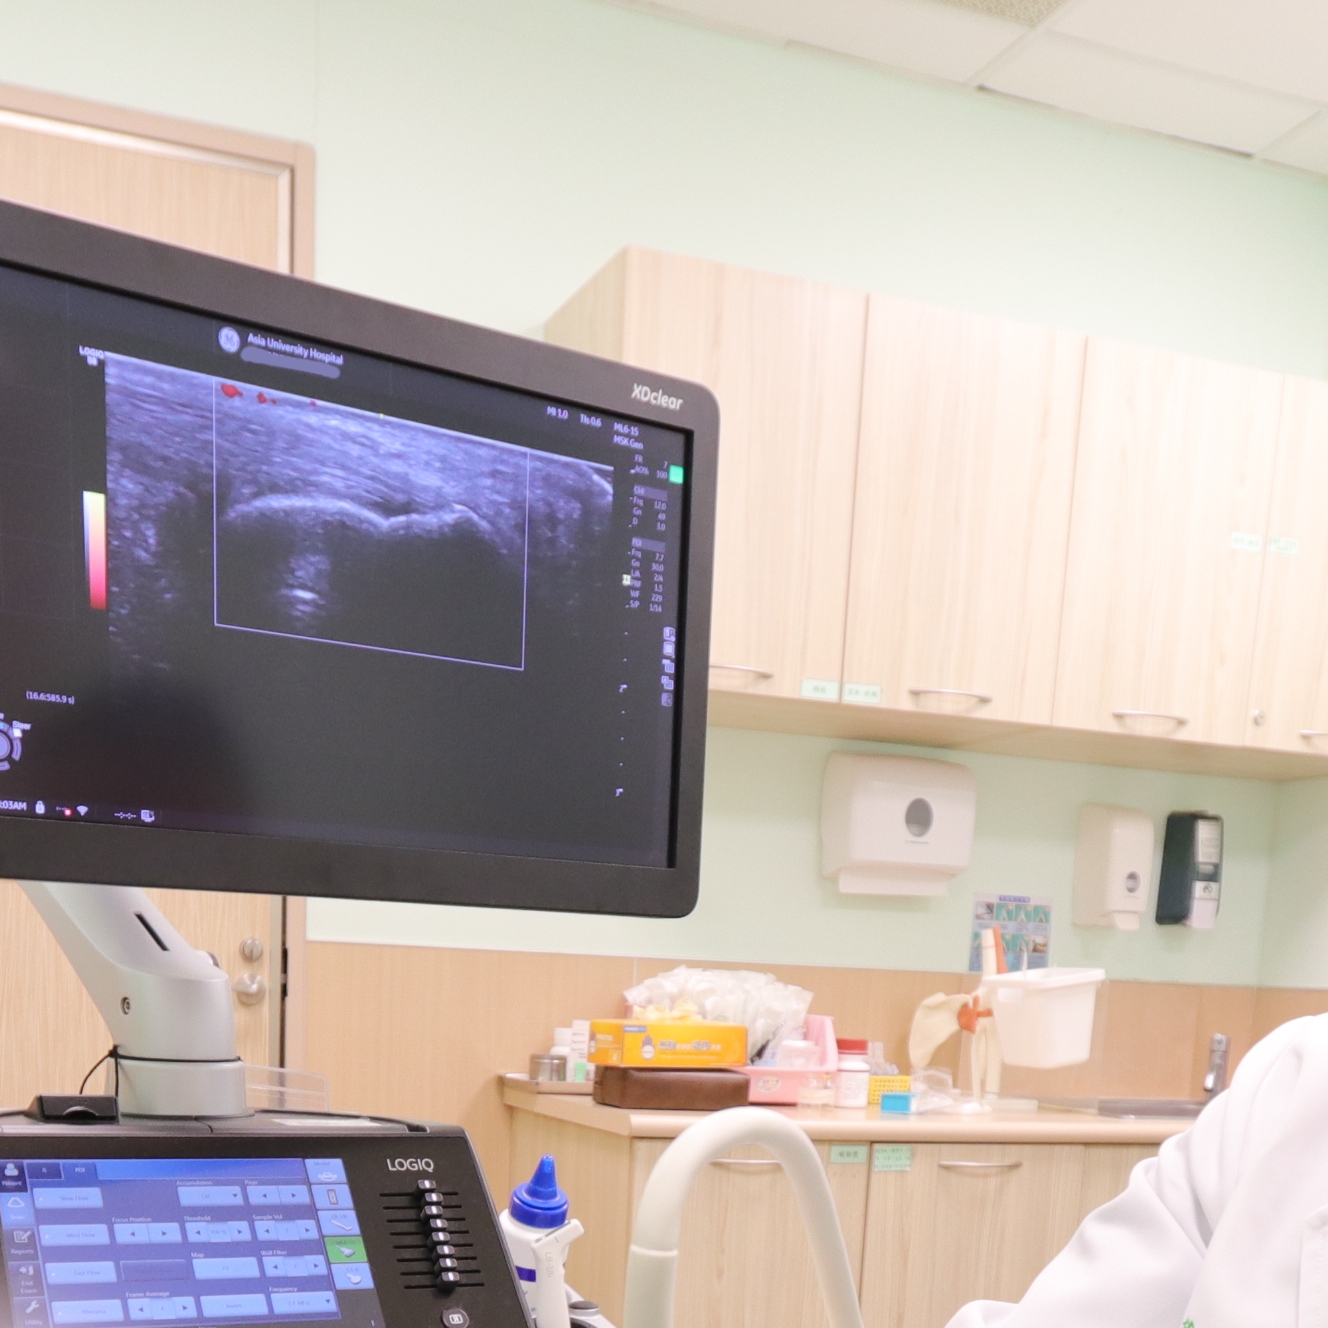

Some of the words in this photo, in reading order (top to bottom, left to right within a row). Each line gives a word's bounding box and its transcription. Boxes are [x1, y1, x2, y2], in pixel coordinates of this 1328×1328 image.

[79, 345, 104, 360] LOGIQ
[247, 333, 266, 347] Asia
[267, 336, 309, 358] University
[309, 347, 344, 366] Hospital
[631, 383, 684, 410] XDclear
[547, 405, 557, 417] MI
[557, 408, 569, 420] 1.0
[580, 414, 590, 425] TIs
[590, 416, 602, 428] 0.6
[614, 422, 639, 437] ML6-15
[613, 434, 629, 447] MSK
[629, 438, 644, 449] Gen
[656, 469, 668, 480] 100
[12, 720, 32, 730] Steer
[386, 1158, 435, 1173] LOGIQ
[145, 1290, 170, 1298] Average
